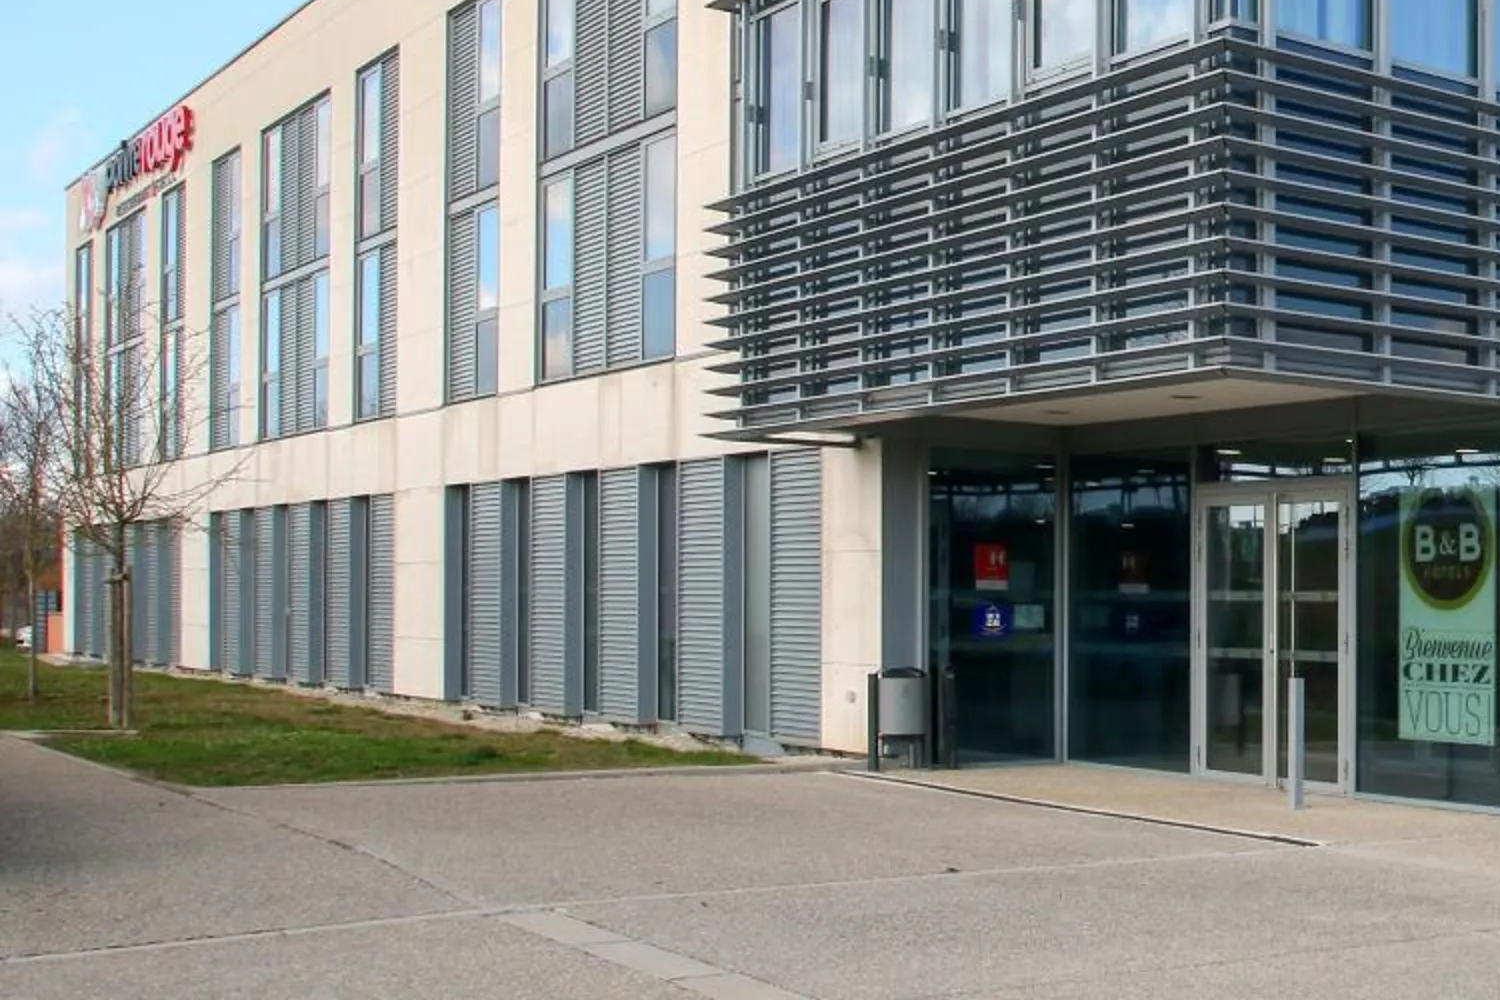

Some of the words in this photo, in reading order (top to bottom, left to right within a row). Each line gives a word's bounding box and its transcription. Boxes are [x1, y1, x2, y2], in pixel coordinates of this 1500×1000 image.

[1415, 523, 1481, 562] B&B
[1404, 626, 1493, 660] Bienvenue
[1403, 662, 1491, 684] CHEZ
